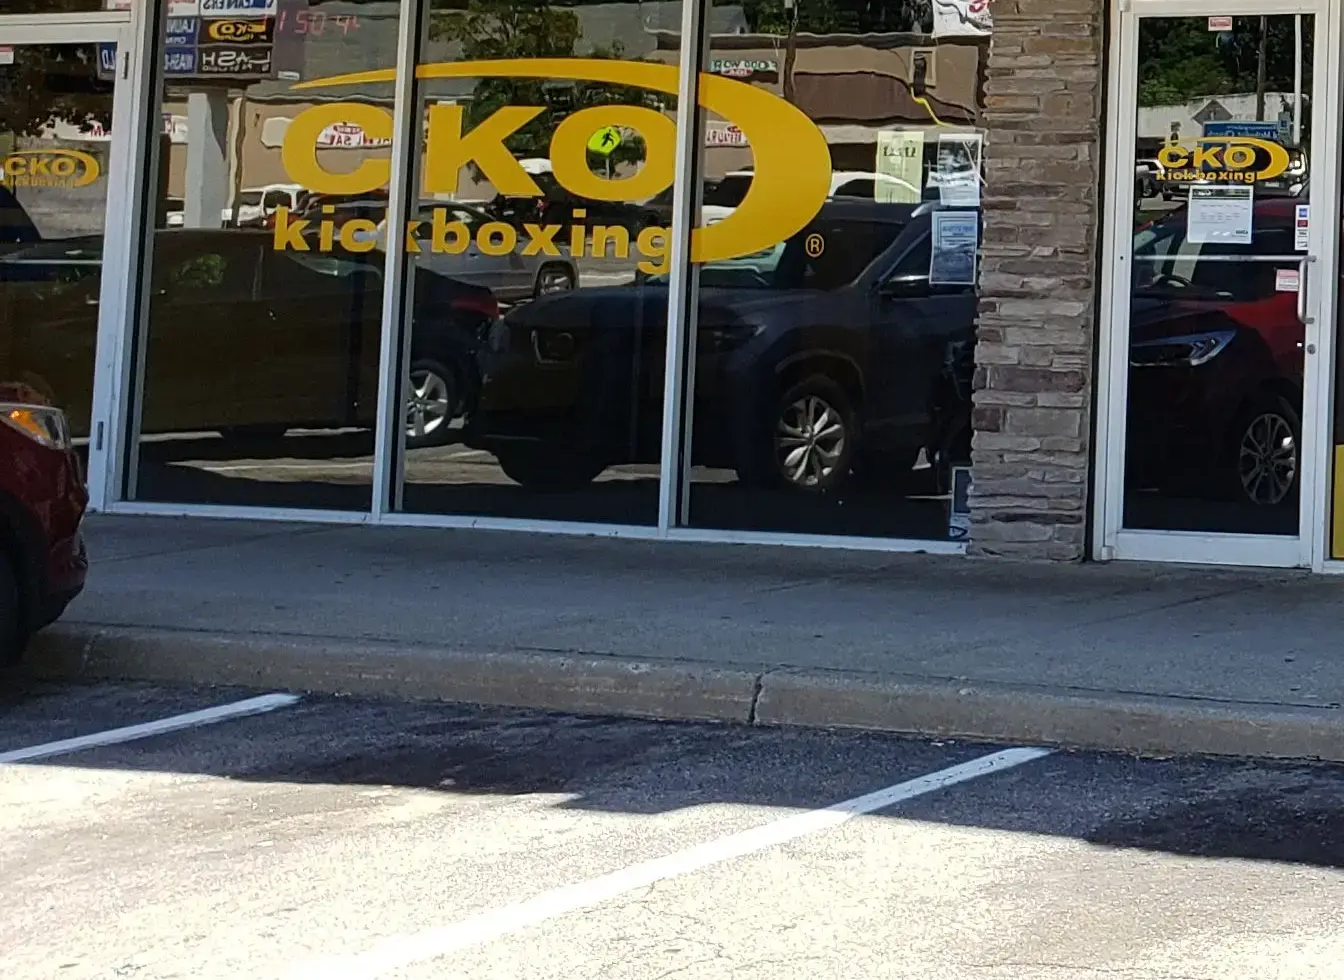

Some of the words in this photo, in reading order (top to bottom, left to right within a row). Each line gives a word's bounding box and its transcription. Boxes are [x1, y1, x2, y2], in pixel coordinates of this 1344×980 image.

[282, 103, 677, 201] CKO
[1157, 146, 1257, 169] CKO
[5, 156, 76, 176] CKO
[1156, 169, 1257, 184] kickboxing
